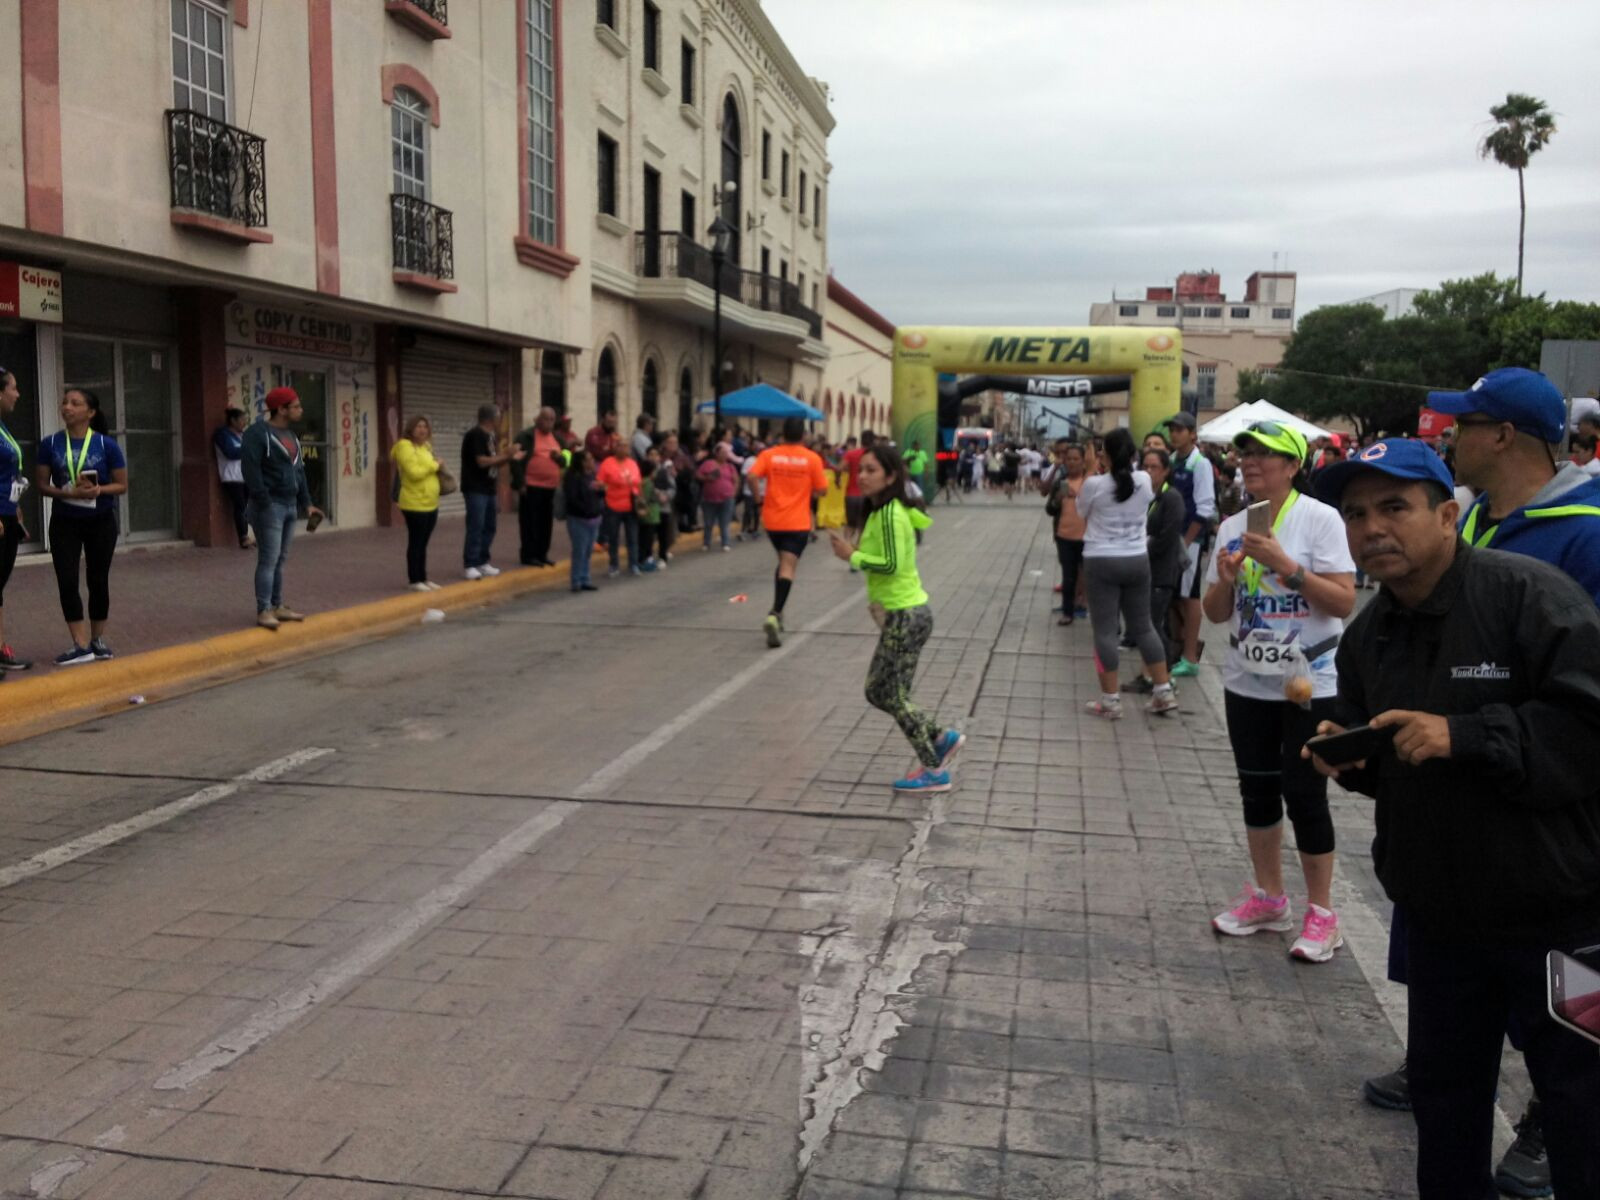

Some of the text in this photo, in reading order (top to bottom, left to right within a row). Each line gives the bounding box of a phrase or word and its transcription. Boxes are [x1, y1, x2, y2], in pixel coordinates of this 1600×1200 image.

[22, 270, 60, 288] Cajero
[255, 308, 352, 342] COPY CENTRO
[984, 336, 1090, 363] META
[1027, 379, 1092, 395] META
[342, 401, 352, 477] COPIA
[1245, 644, 1294, 663] 1034
